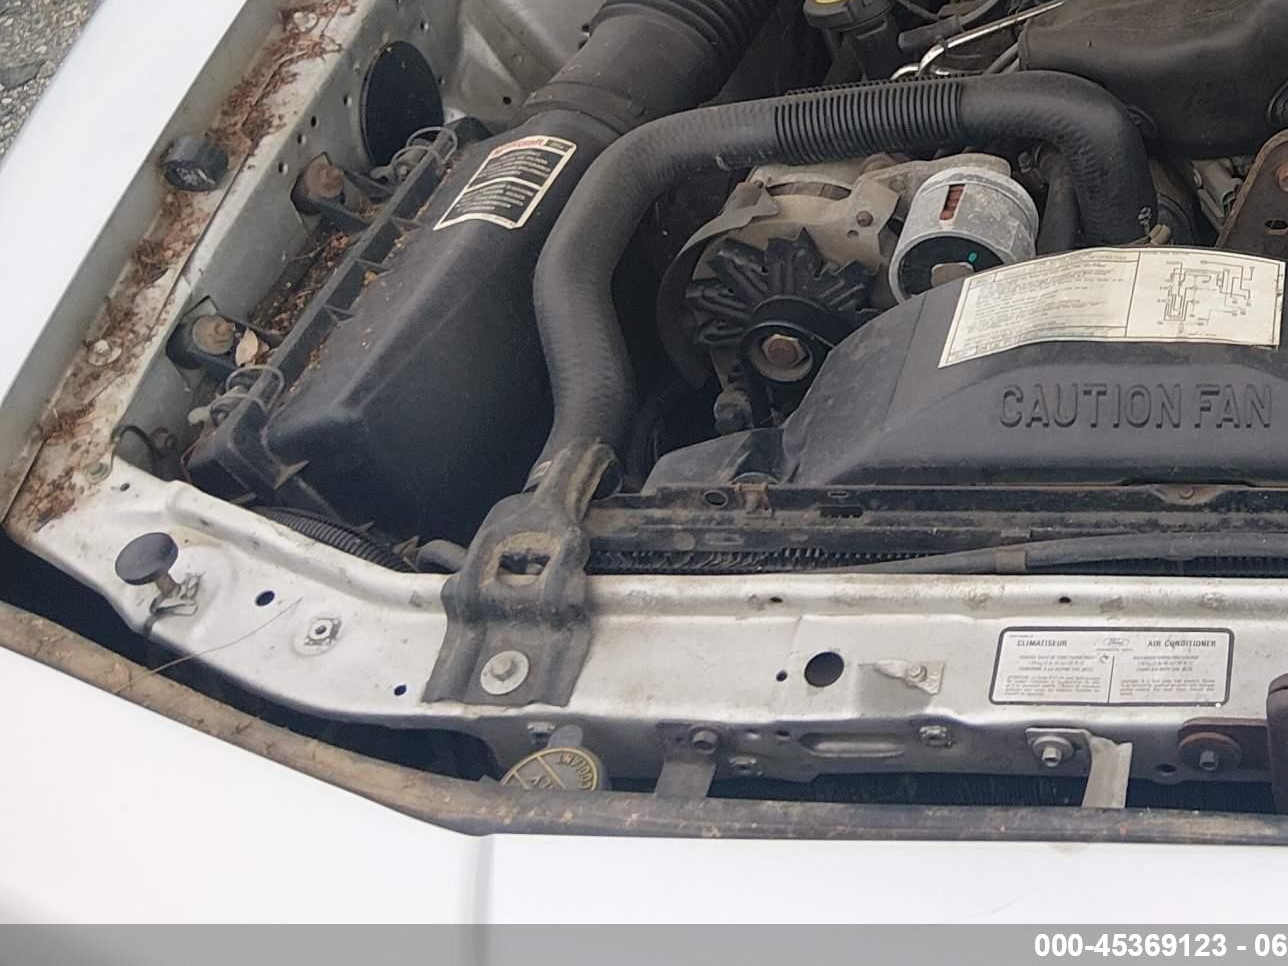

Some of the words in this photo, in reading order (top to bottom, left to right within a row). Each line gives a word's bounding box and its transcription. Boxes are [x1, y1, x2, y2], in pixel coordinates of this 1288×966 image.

[1000, 384, 1182, 429] CAUTION
[1194, 383, 1272, 429] FAN
[1164, 640, 1217, 648] CONDITIONER
